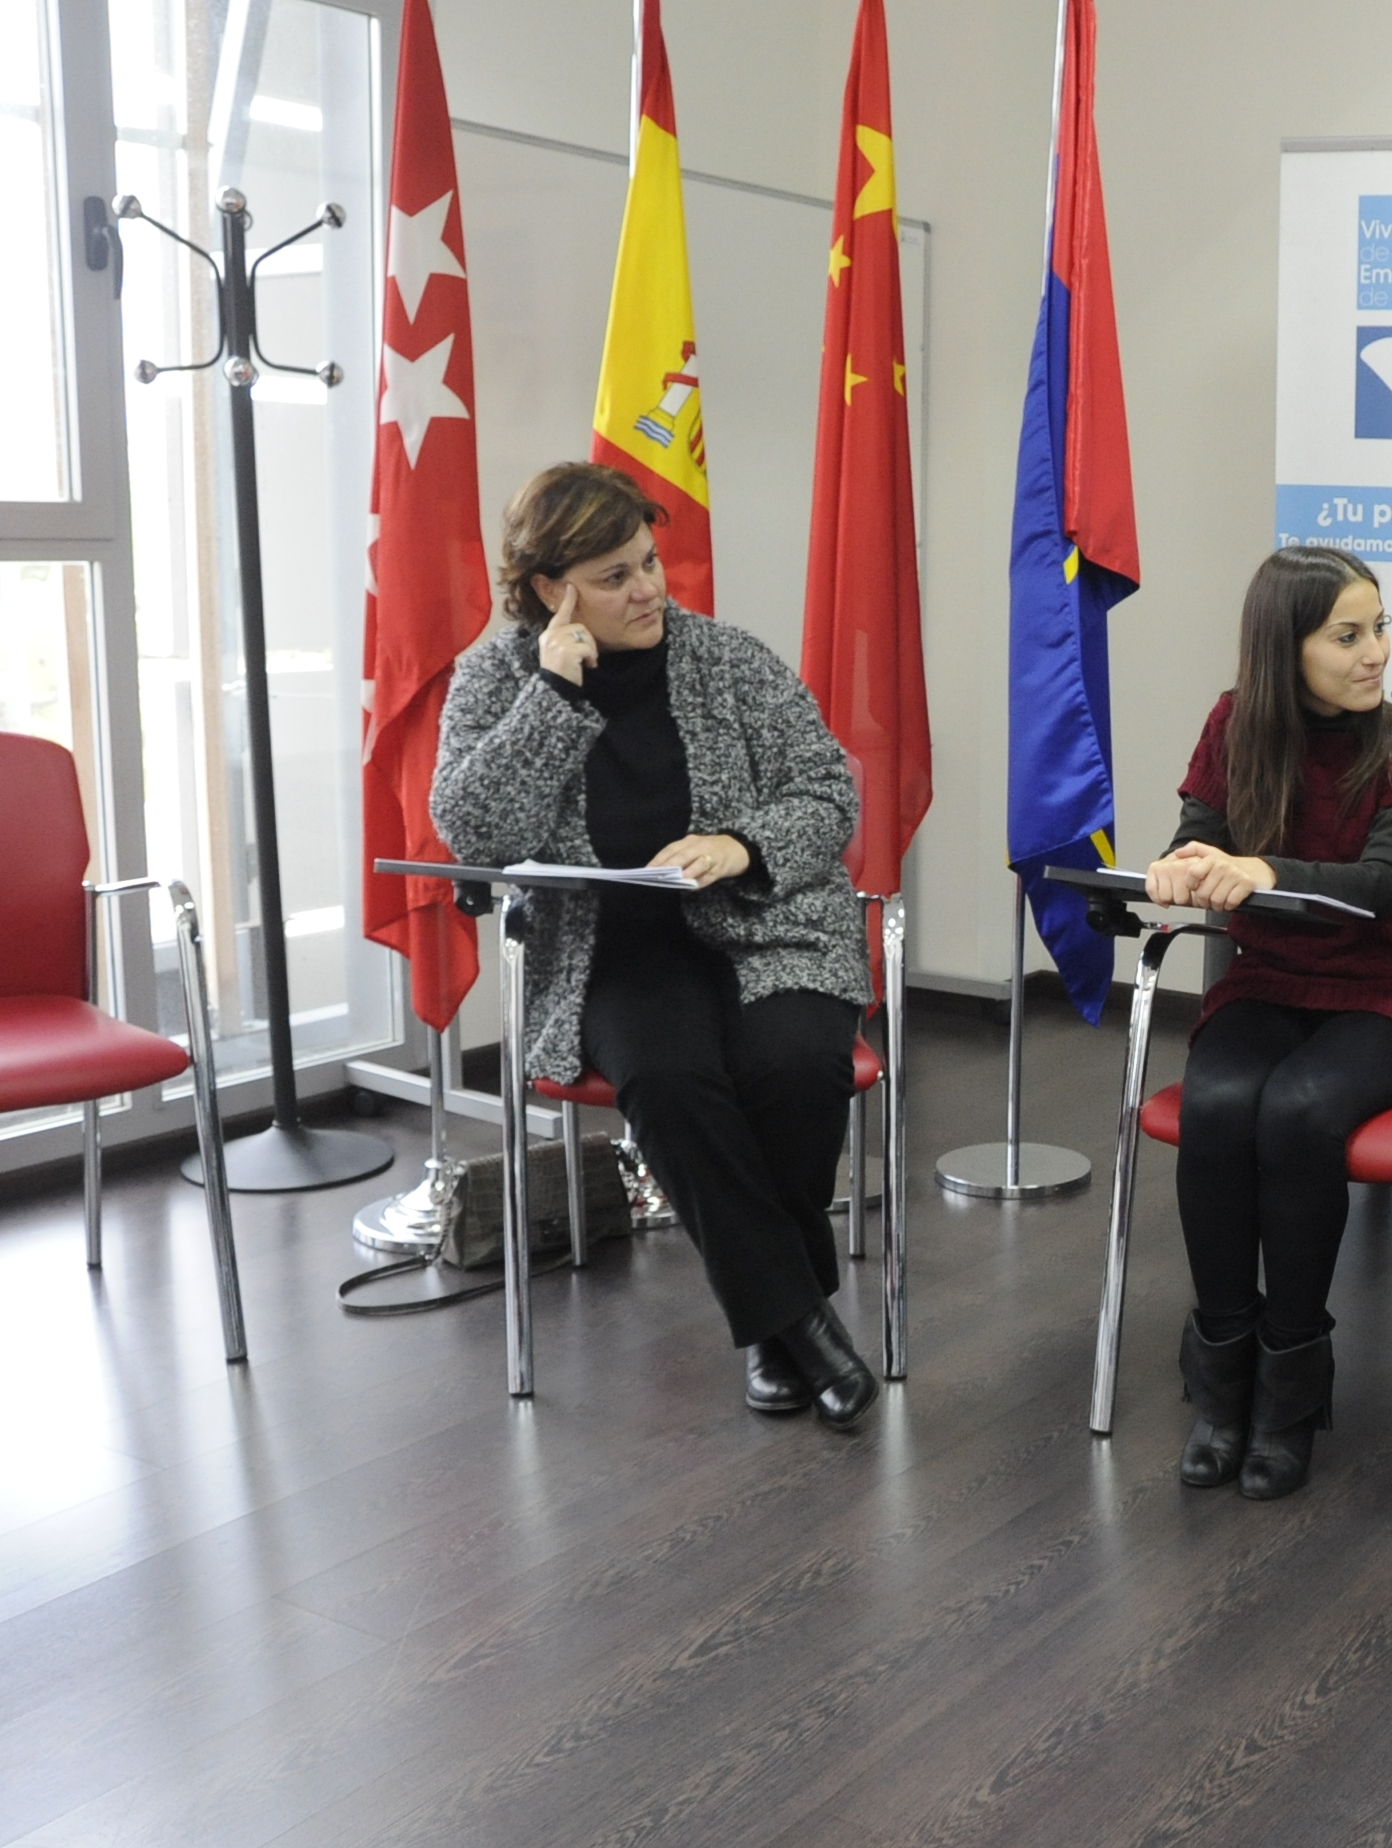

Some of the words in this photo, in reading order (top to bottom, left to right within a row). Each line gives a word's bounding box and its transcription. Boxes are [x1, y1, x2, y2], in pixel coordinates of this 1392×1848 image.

[1360, 243, 1389, 262] de
[1360, 287, 1389, 307] de
[1317, 497, 1364, 528] ¿Tu
[1278, 533, 1300, 548] Te
